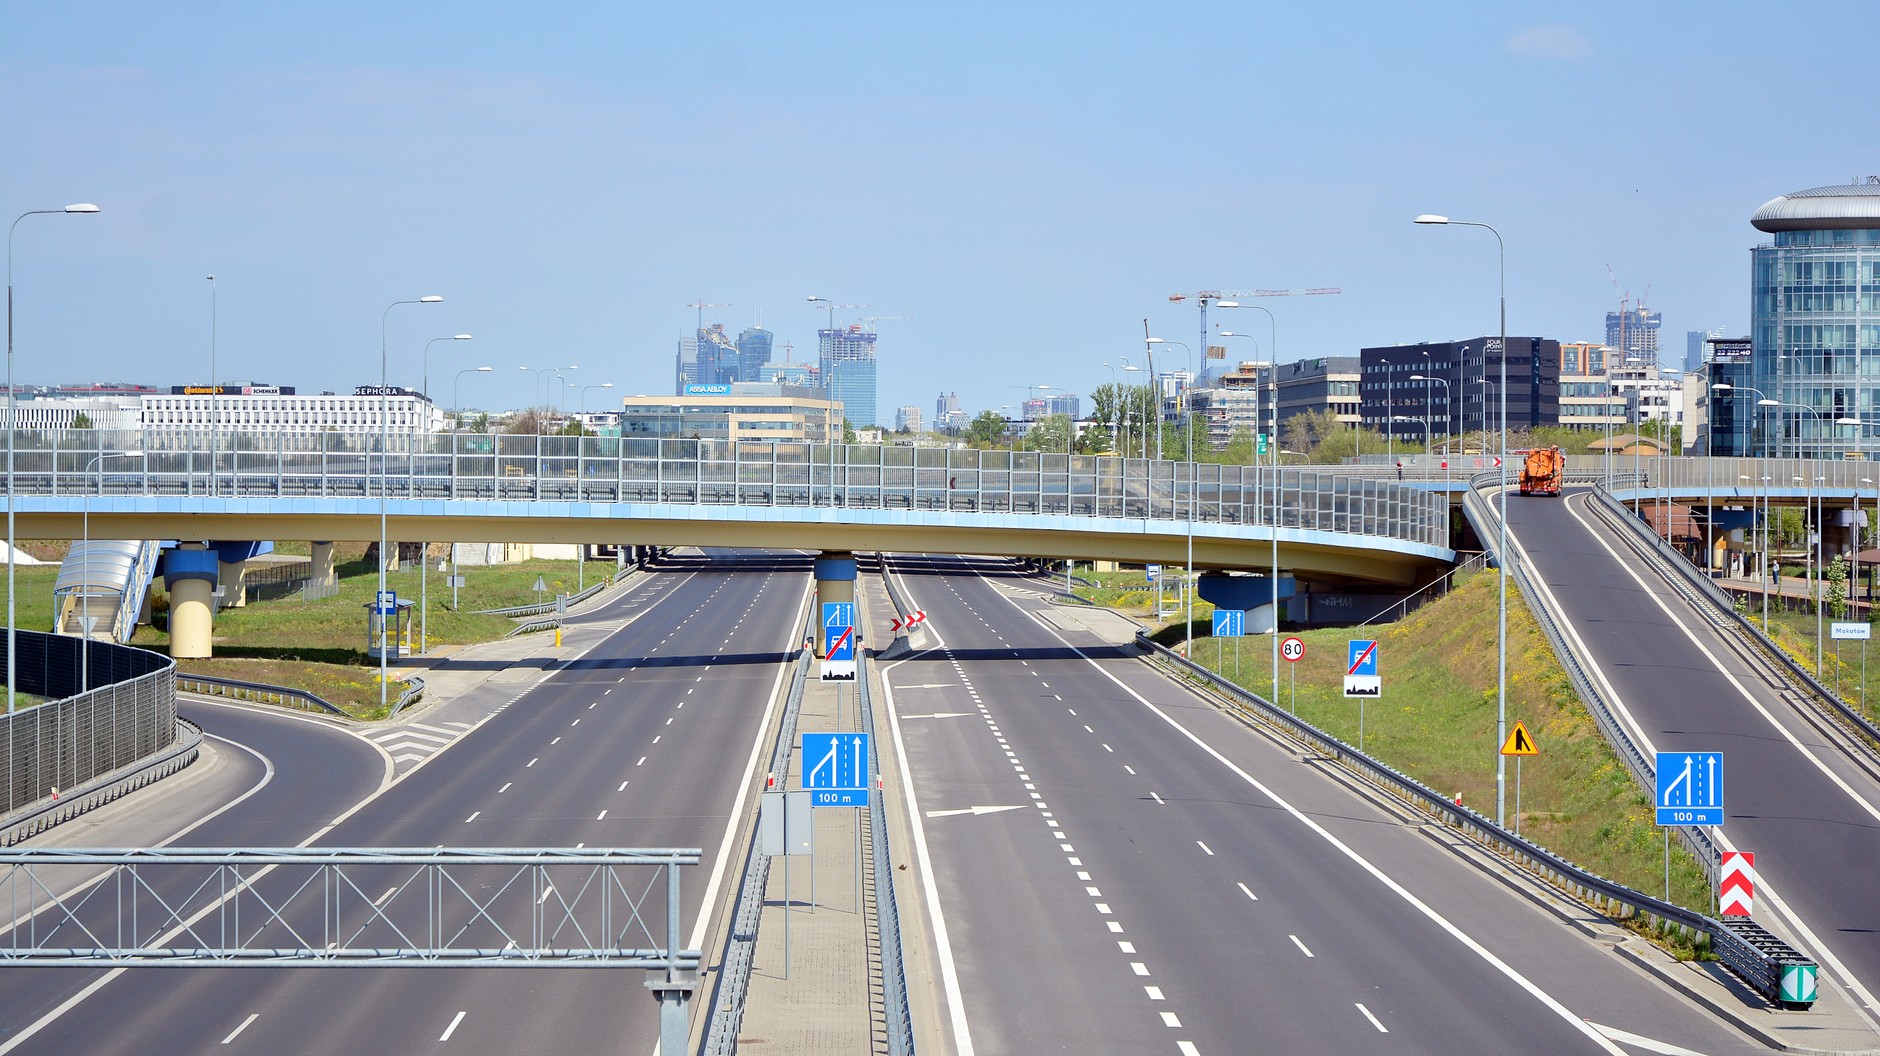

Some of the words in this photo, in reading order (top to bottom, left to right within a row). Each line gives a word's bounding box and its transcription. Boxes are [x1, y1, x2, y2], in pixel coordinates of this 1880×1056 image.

[689, 385, 706, 393] ASSA
[707, 385, 728, 393] ABLOY
[1284, 643, 1302, 655] 80
[819, 793, 838, 803] 100
[842, 795, 851, 803] m
[1673, 812, 1693, 822] 100
[1697, 814, 1706, 822] m
